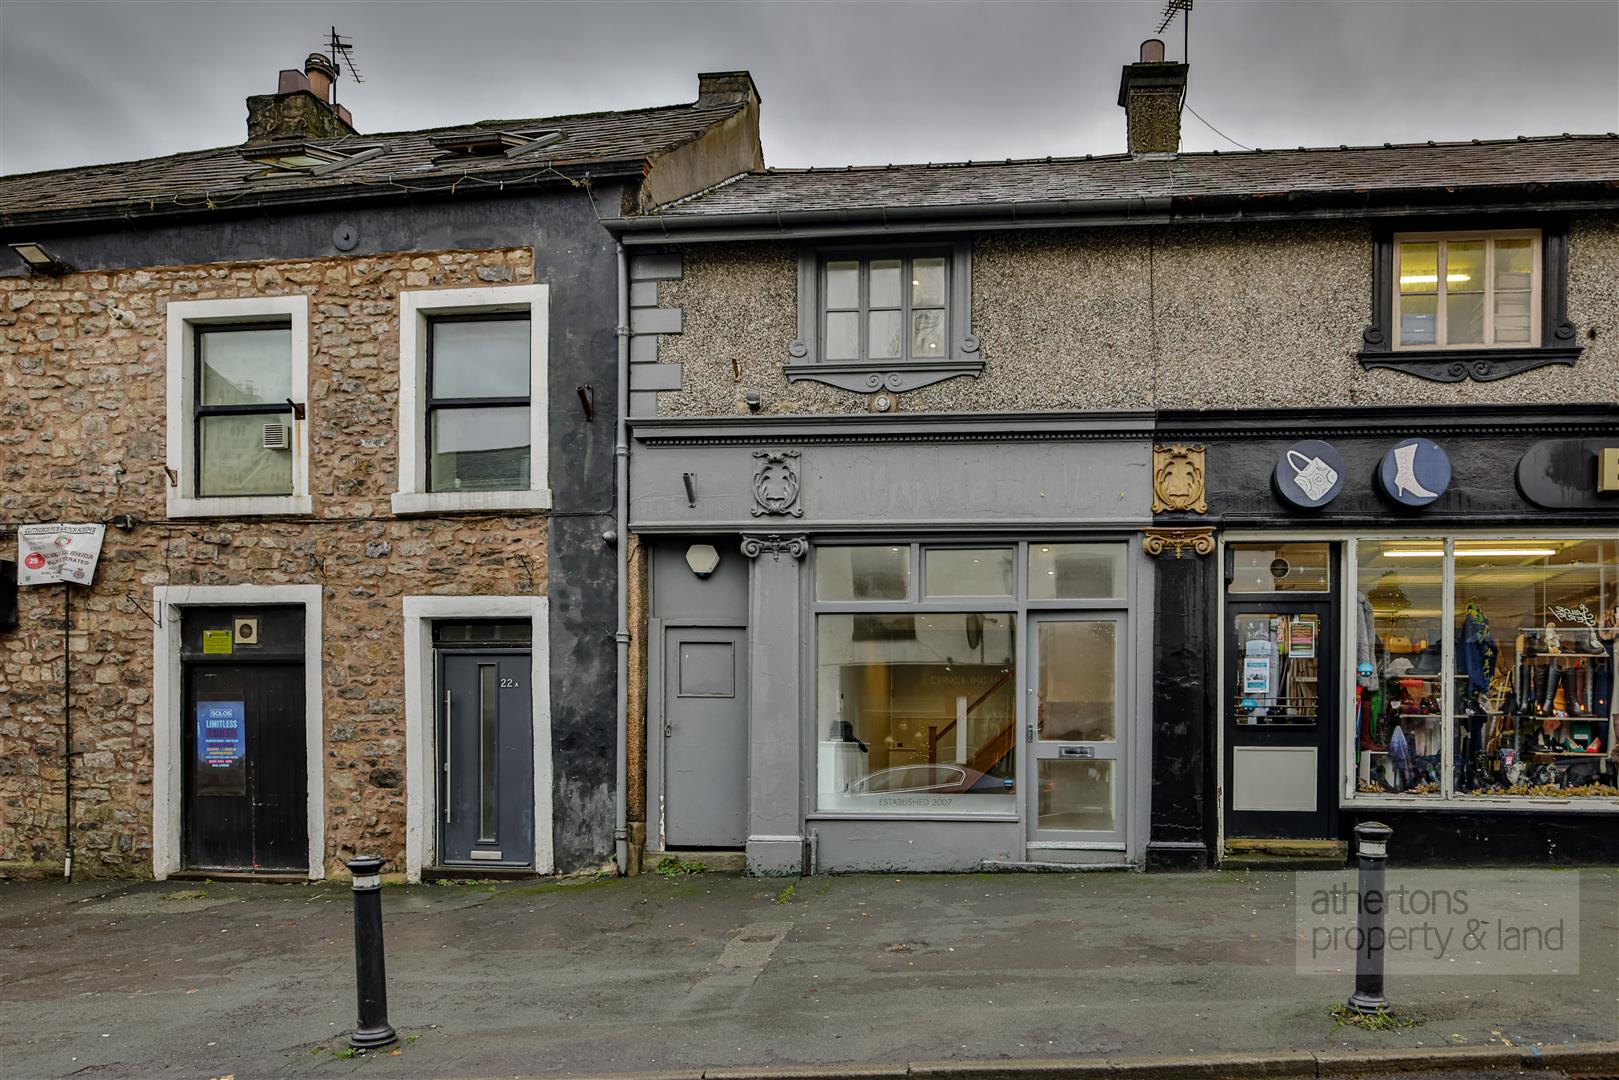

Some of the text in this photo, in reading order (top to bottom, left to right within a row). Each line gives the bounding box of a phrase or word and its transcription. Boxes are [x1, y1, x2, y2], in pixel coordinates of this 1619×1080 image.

[206, 719, 238, 729] LIMITLESS
[879, 798, 953, 807] ESTABLISHED 2007
